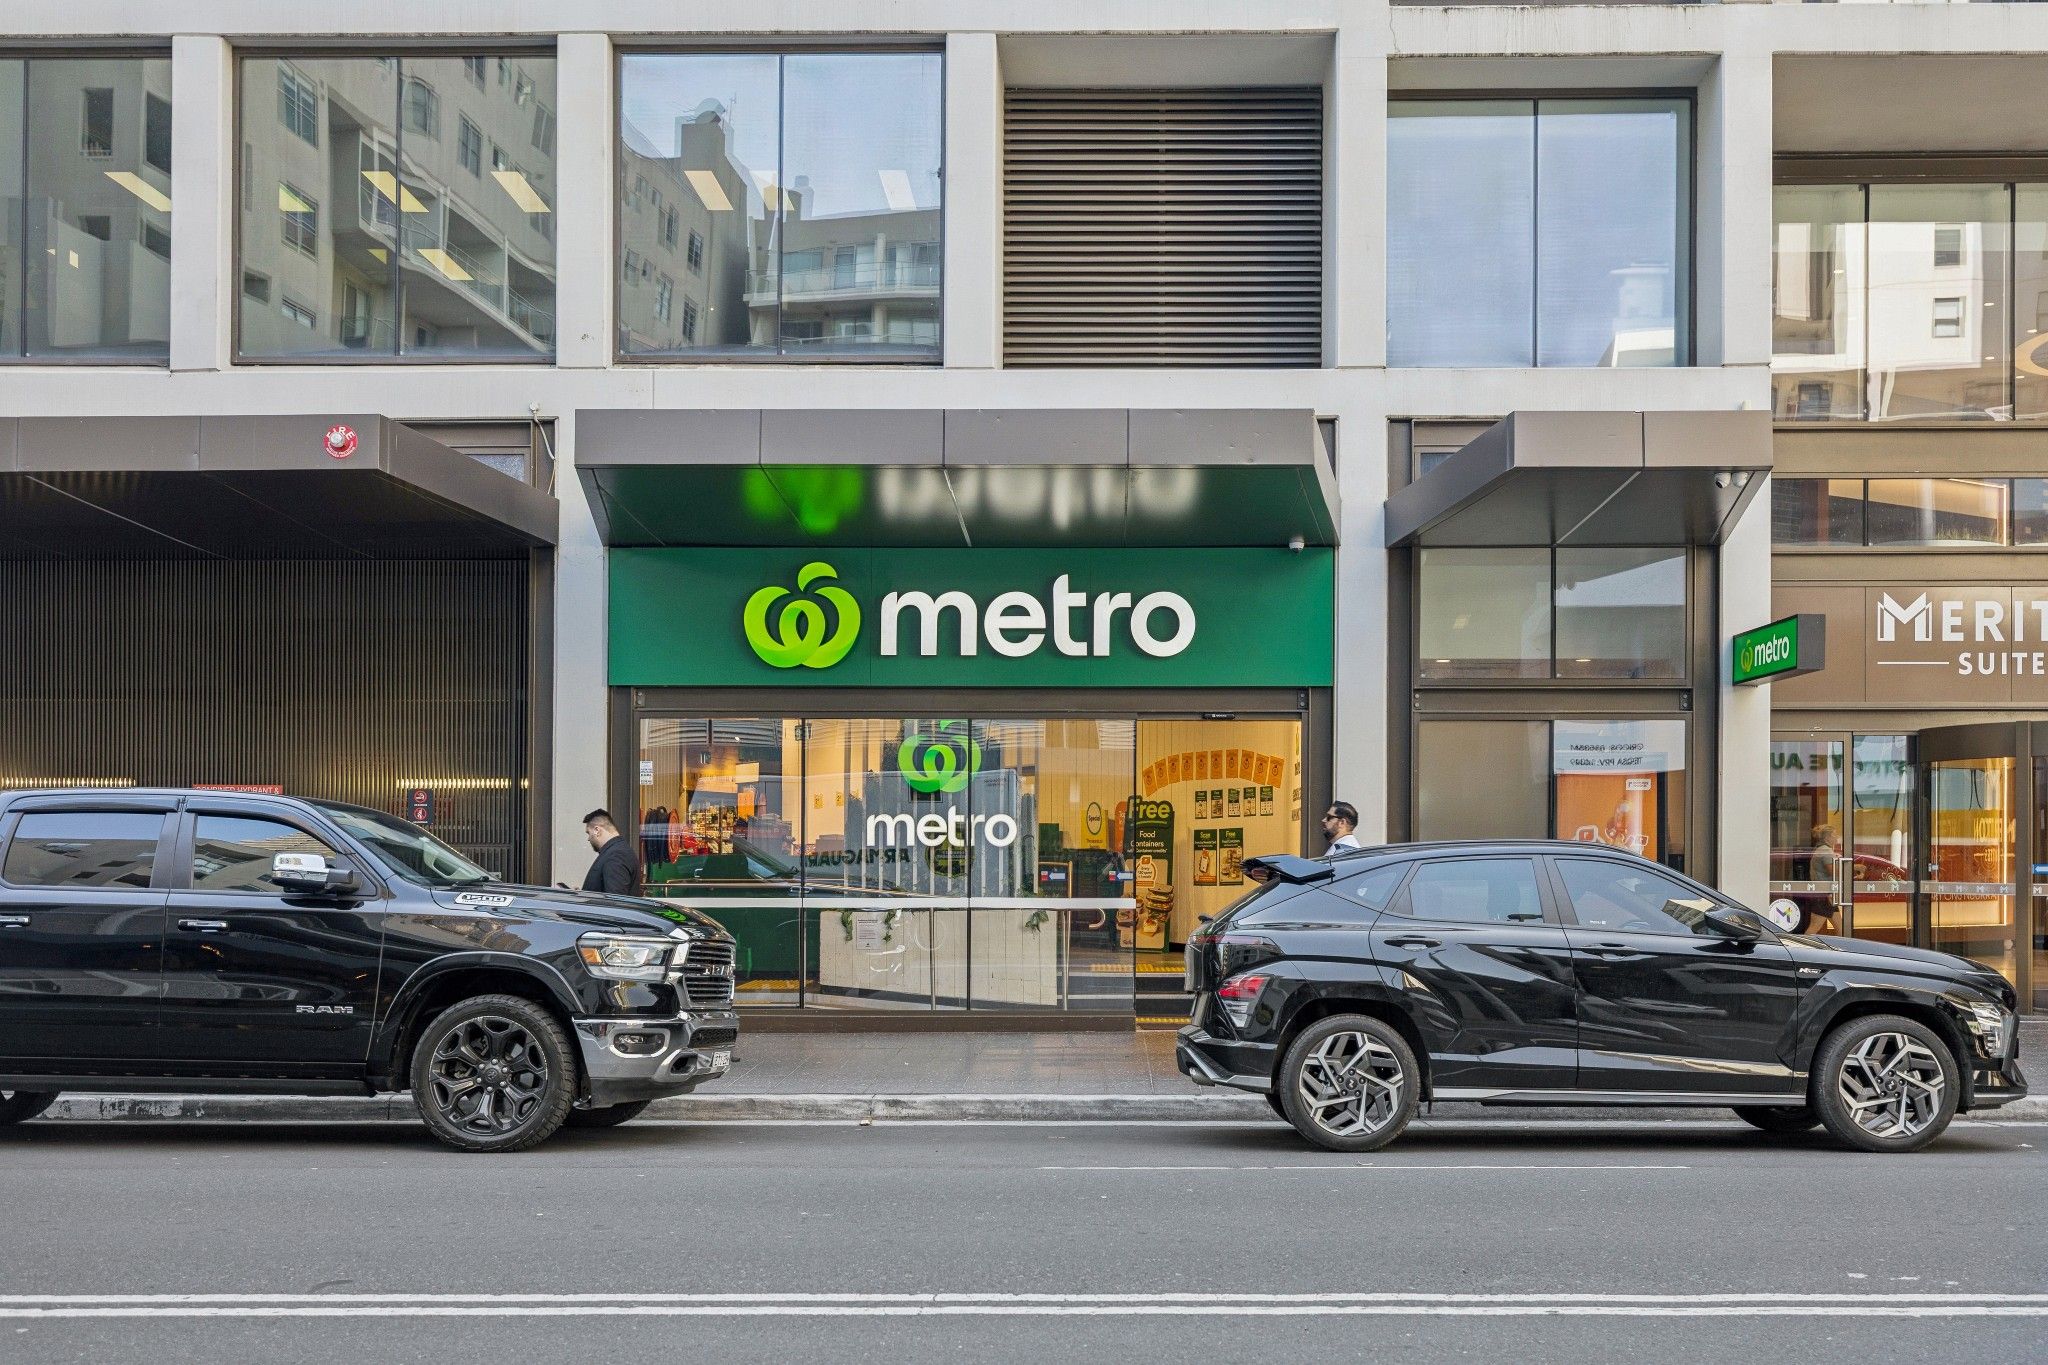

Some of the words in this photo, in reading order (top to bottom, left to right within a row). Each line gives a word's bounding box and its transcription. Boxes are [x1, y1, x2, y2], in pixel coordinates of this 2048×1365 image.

[880, 574, 1196, 657] metro
[1753, 633, 1790, 667] metro
[1958, 652, 2045, 675] SUITE
[1128, 797, 1170, 819] Free
[866, 805, 1017, 848] metro
[1139, 830, 1156, 838] Food
[1130, 839, 1165, 848] Containers
[296, 1005, 353, 1014] RAM
